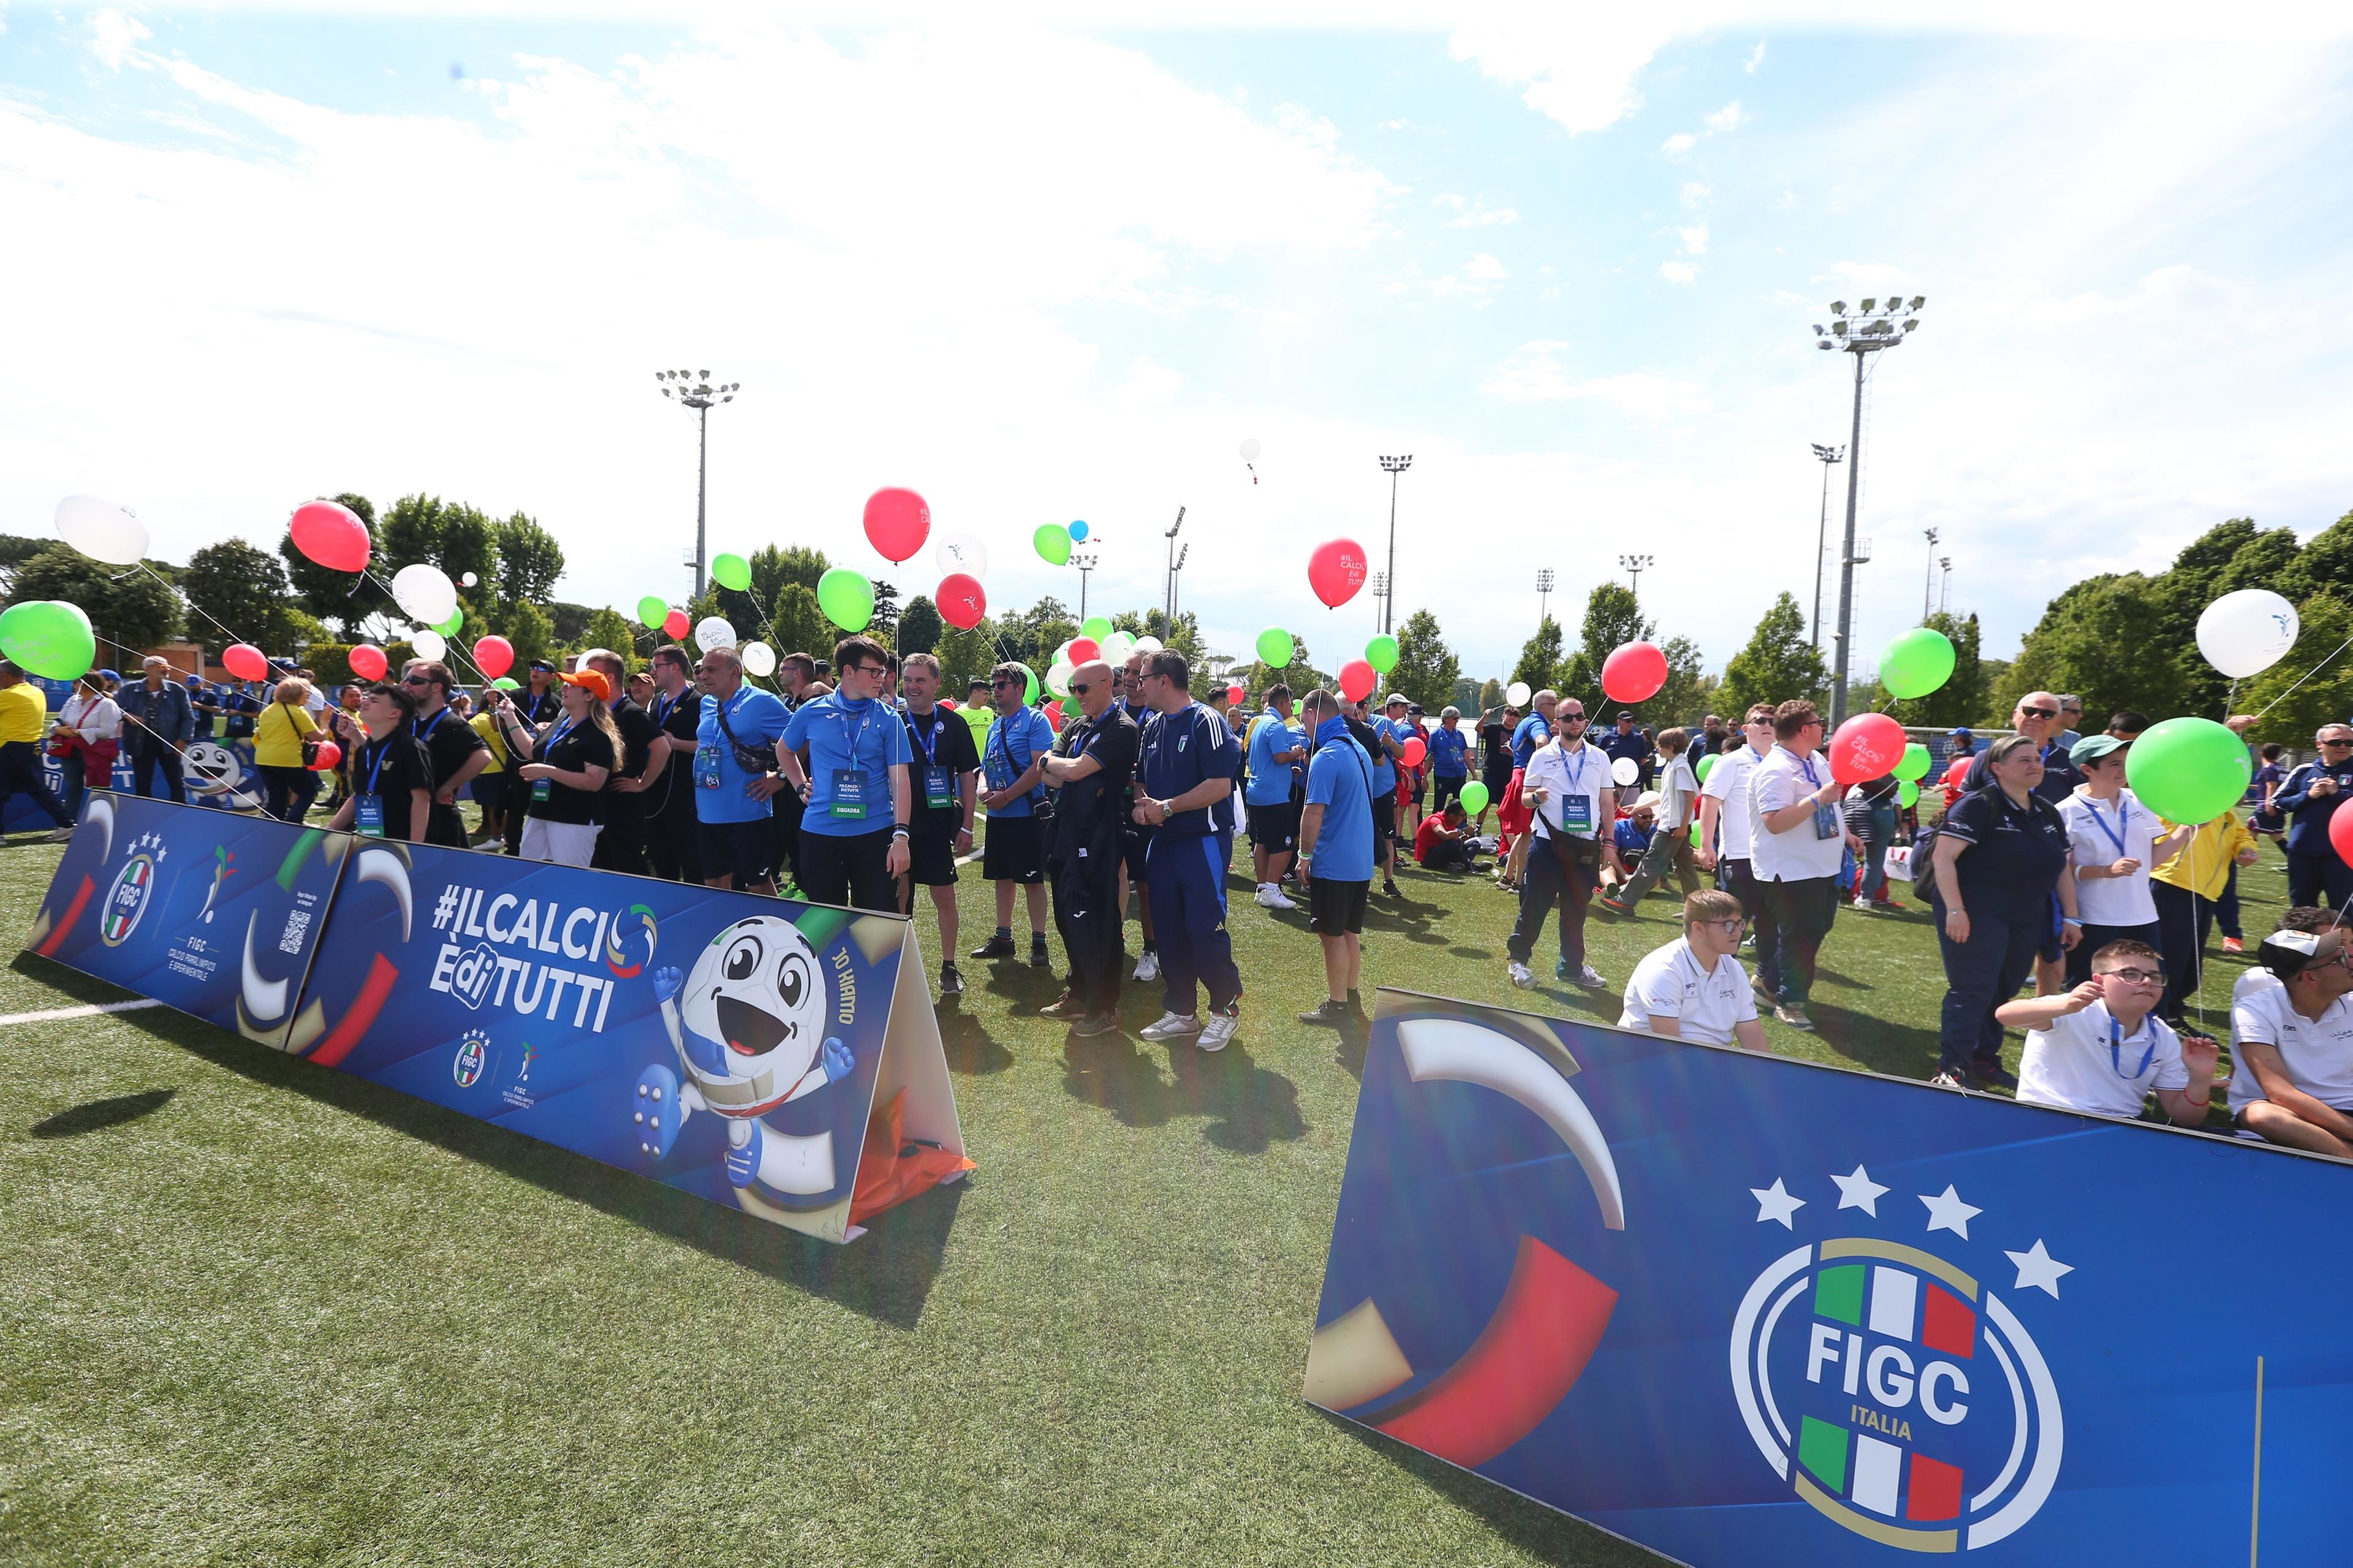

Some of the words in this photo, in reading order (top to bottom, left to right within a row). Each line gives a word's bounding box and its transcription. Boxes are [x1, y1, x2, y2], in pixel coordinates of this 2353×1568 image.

[1849, 759, 1873, 775] TUTTI
[115, 884, 142, 907] FIGC
[187, 936, 207, 952] FIGC
[832, 946, 850, 970] JO
[838, 968, 856, 1025] KIAMO
[461, 1055, 477, 1069] FIGC
[513, 1086, 526, 1095] FIGC
[1806, 1322, 1970, 1426] FIGC
[1850, 1404, 1912, 1442] ITALIA
